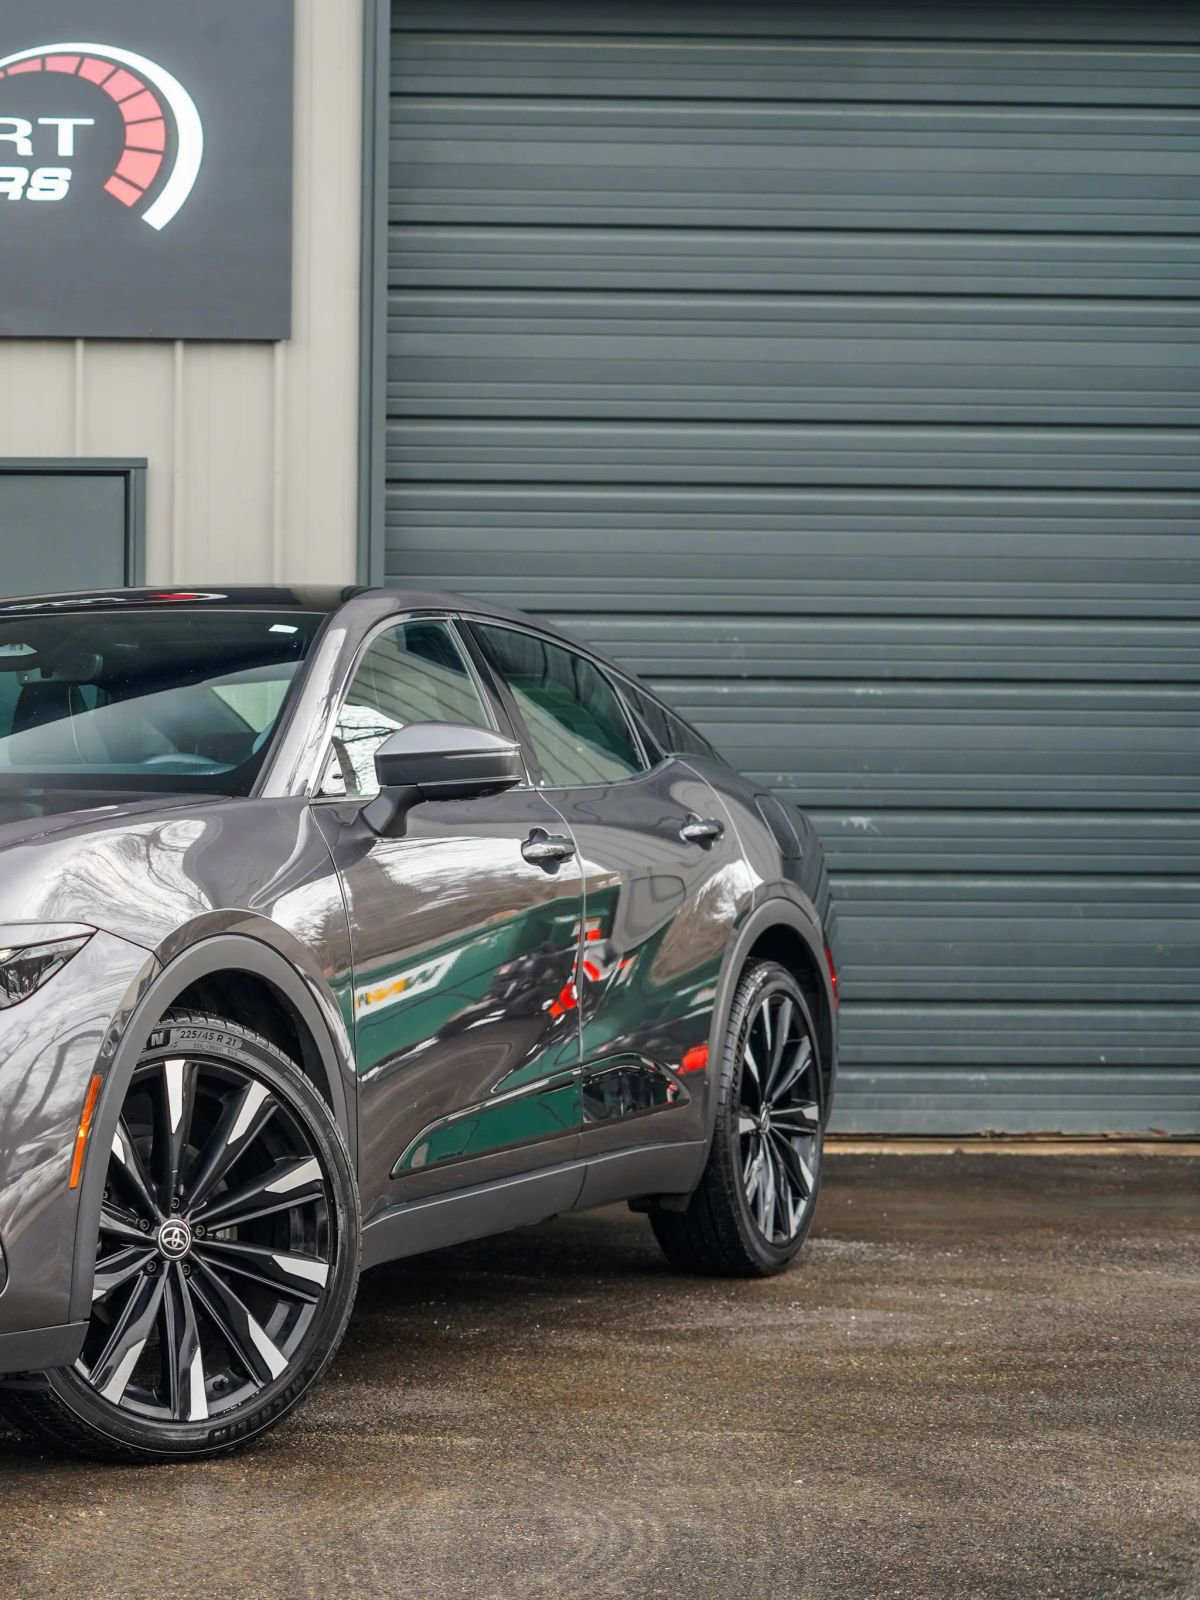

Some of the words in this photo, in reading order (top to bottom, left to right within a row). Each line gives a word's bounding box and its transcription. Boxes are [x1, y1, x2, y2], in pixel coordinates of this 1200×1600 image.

[179, 1030, 215, 1042] 225/45
[216, 1034, 224, 1043] R
[225, 1037, 236, 1047] 21
[213, 1374, 306, 1442] MICHELIN
